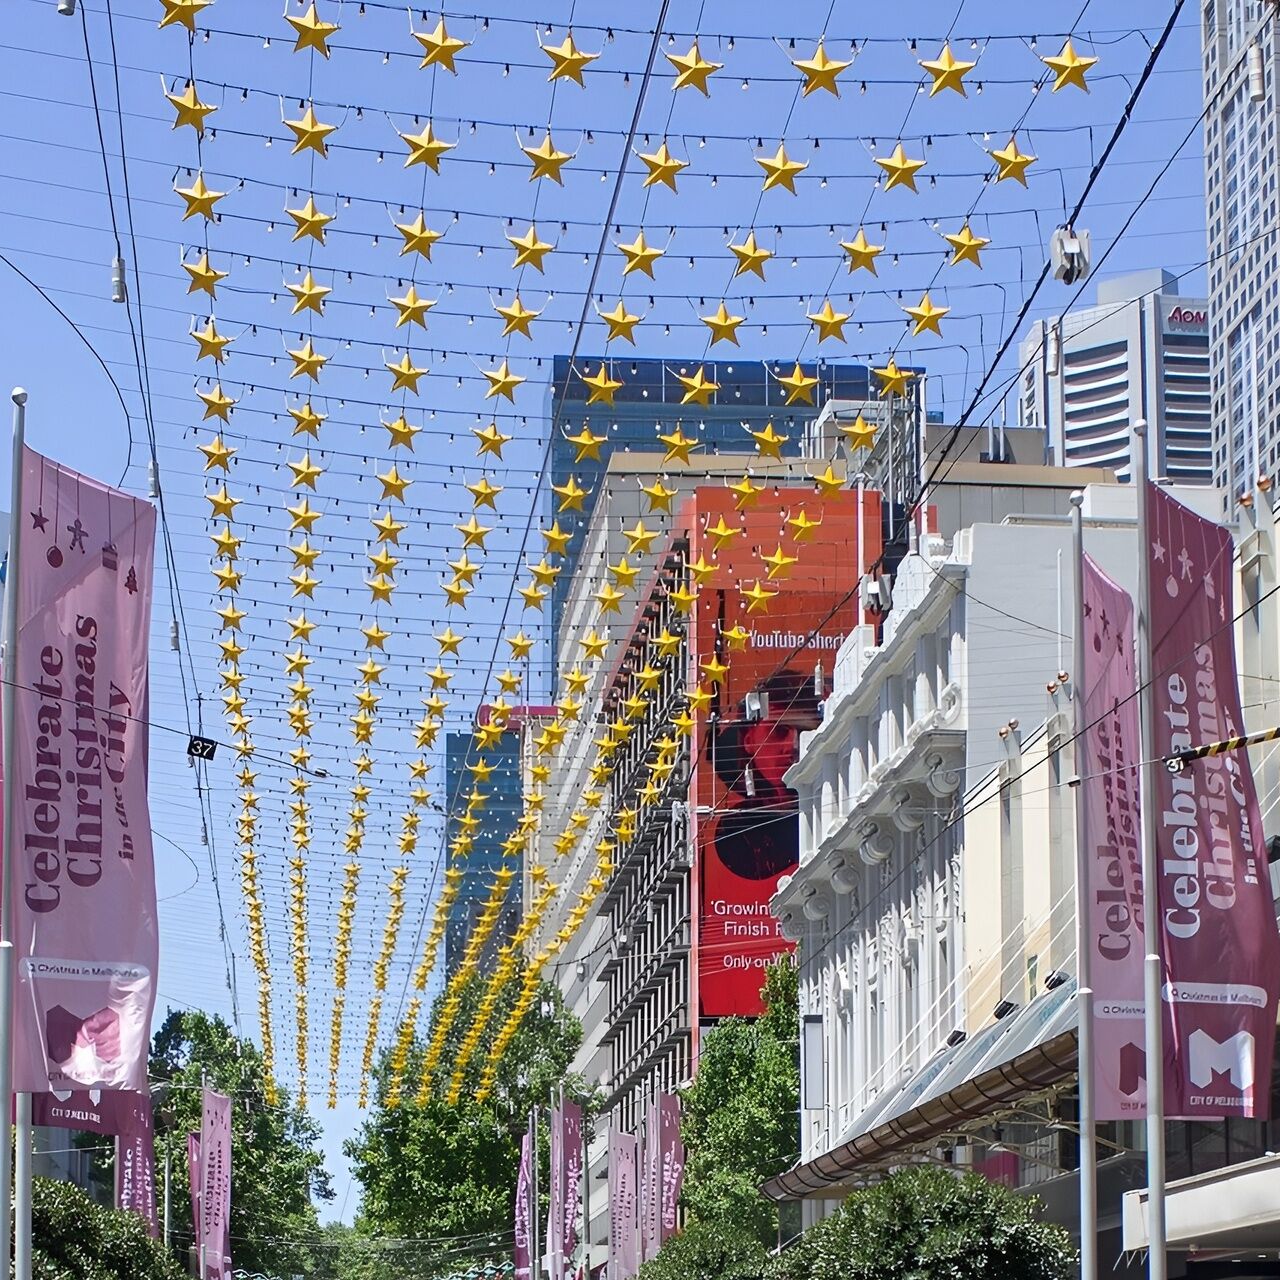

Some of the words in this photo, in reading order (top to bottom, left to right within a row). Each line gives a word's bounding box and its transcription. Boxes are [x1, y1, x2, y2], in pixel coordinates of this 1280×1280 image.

[750, 630, 804, 648] YouTube
[101, 680, 132, 783] City
[65, 614, 102, 888] Christmas
[192, 740, 212, 756] 37
[25, 645, 64, 913] Celebrate
[724, 921, 770, 936] Finish
[723, 955, 751, 970] Only
